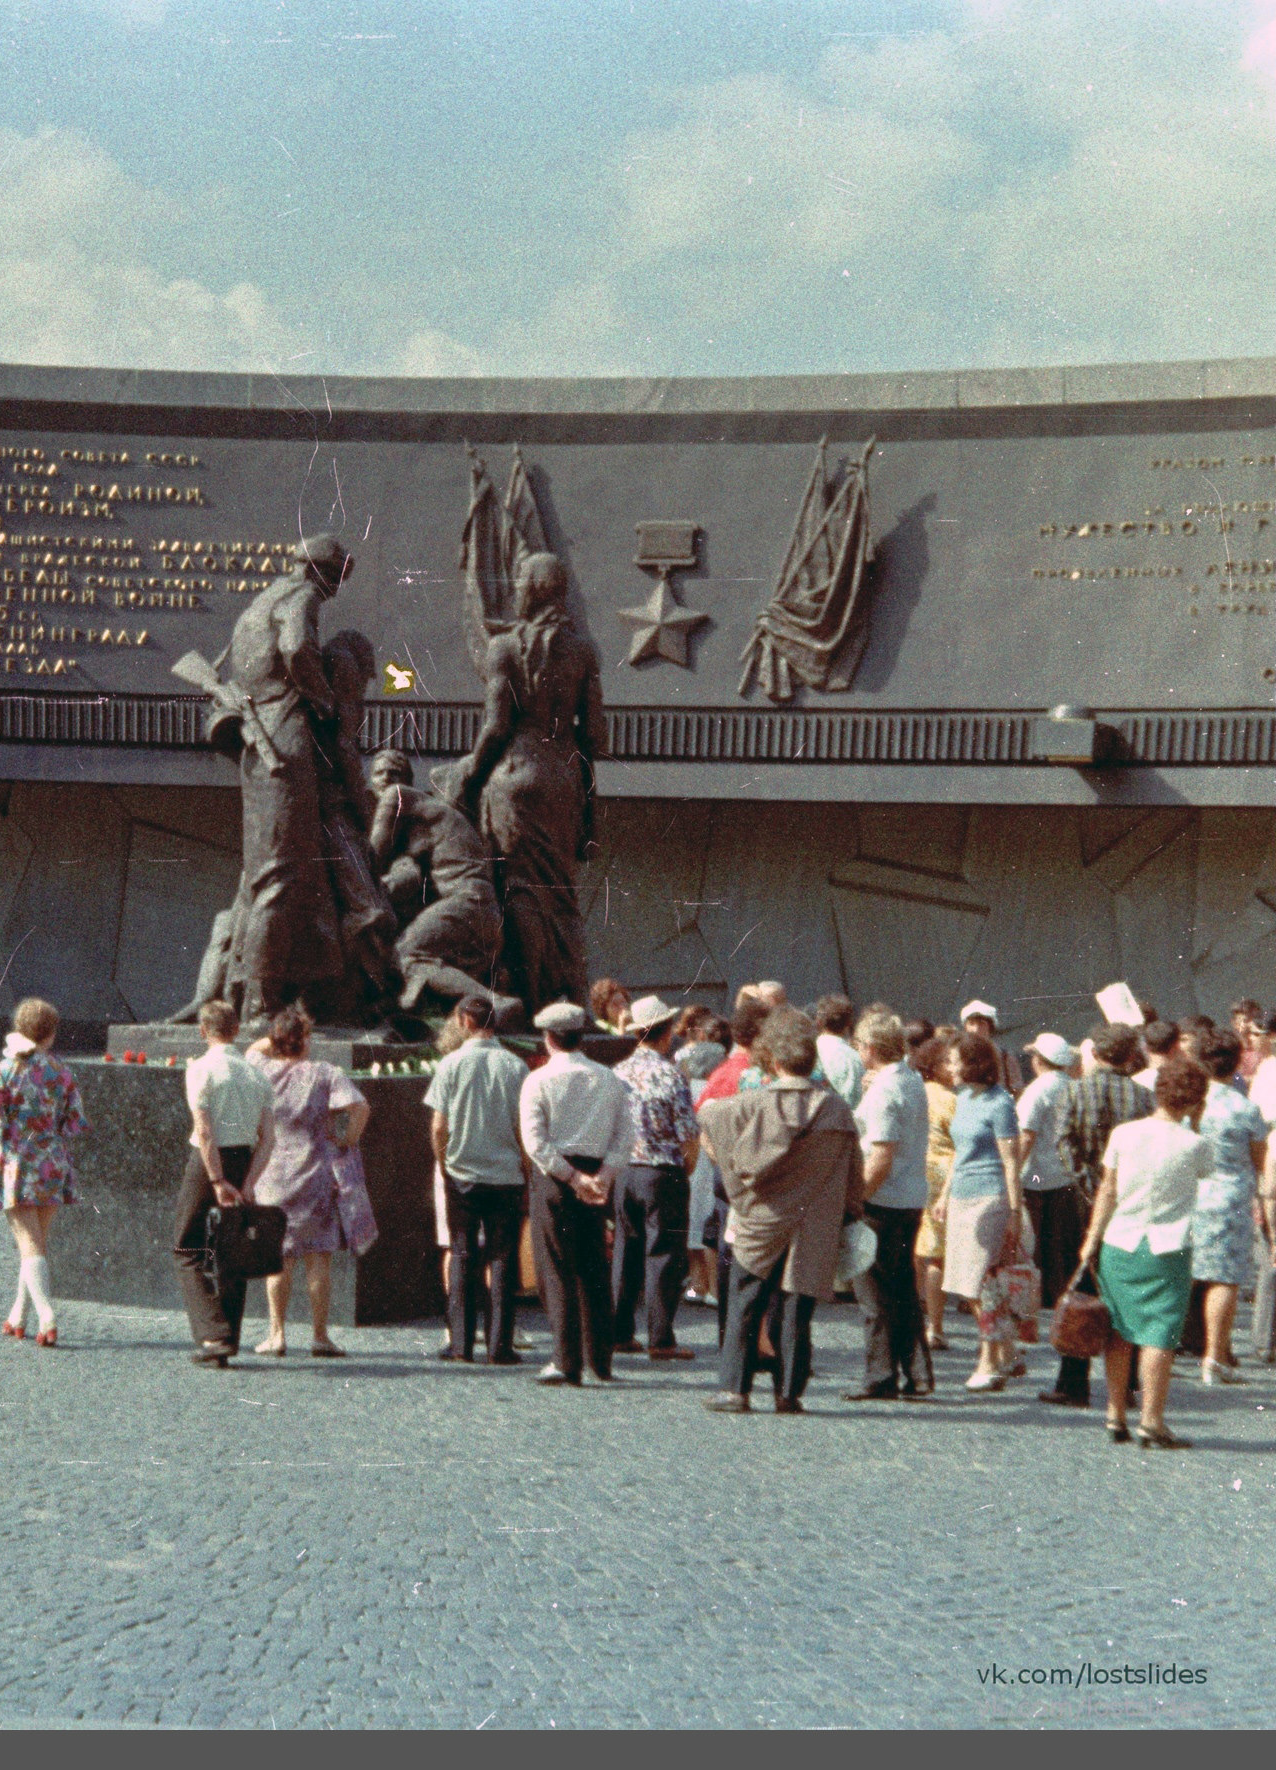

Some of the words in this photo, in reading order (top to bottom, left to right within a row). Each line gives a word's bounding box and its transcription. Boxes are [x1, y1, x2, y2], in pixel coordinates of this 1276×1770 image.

[60, 449, 129, 464] СОВЕТА
[145, 452, 200, 467] СССР
[13, 462, 58, 476] ГОДА
[74, 482, 203, 506] РОДИНОЙ,
[20, 553, 140, 568] ВРАЖЕСКОЙ
[86, 575, 213, 590] СОВЕТСКОГО
[226, 580, 270, 592] НАРО
[114, 591, 199, 608] ВОЙНЕ
